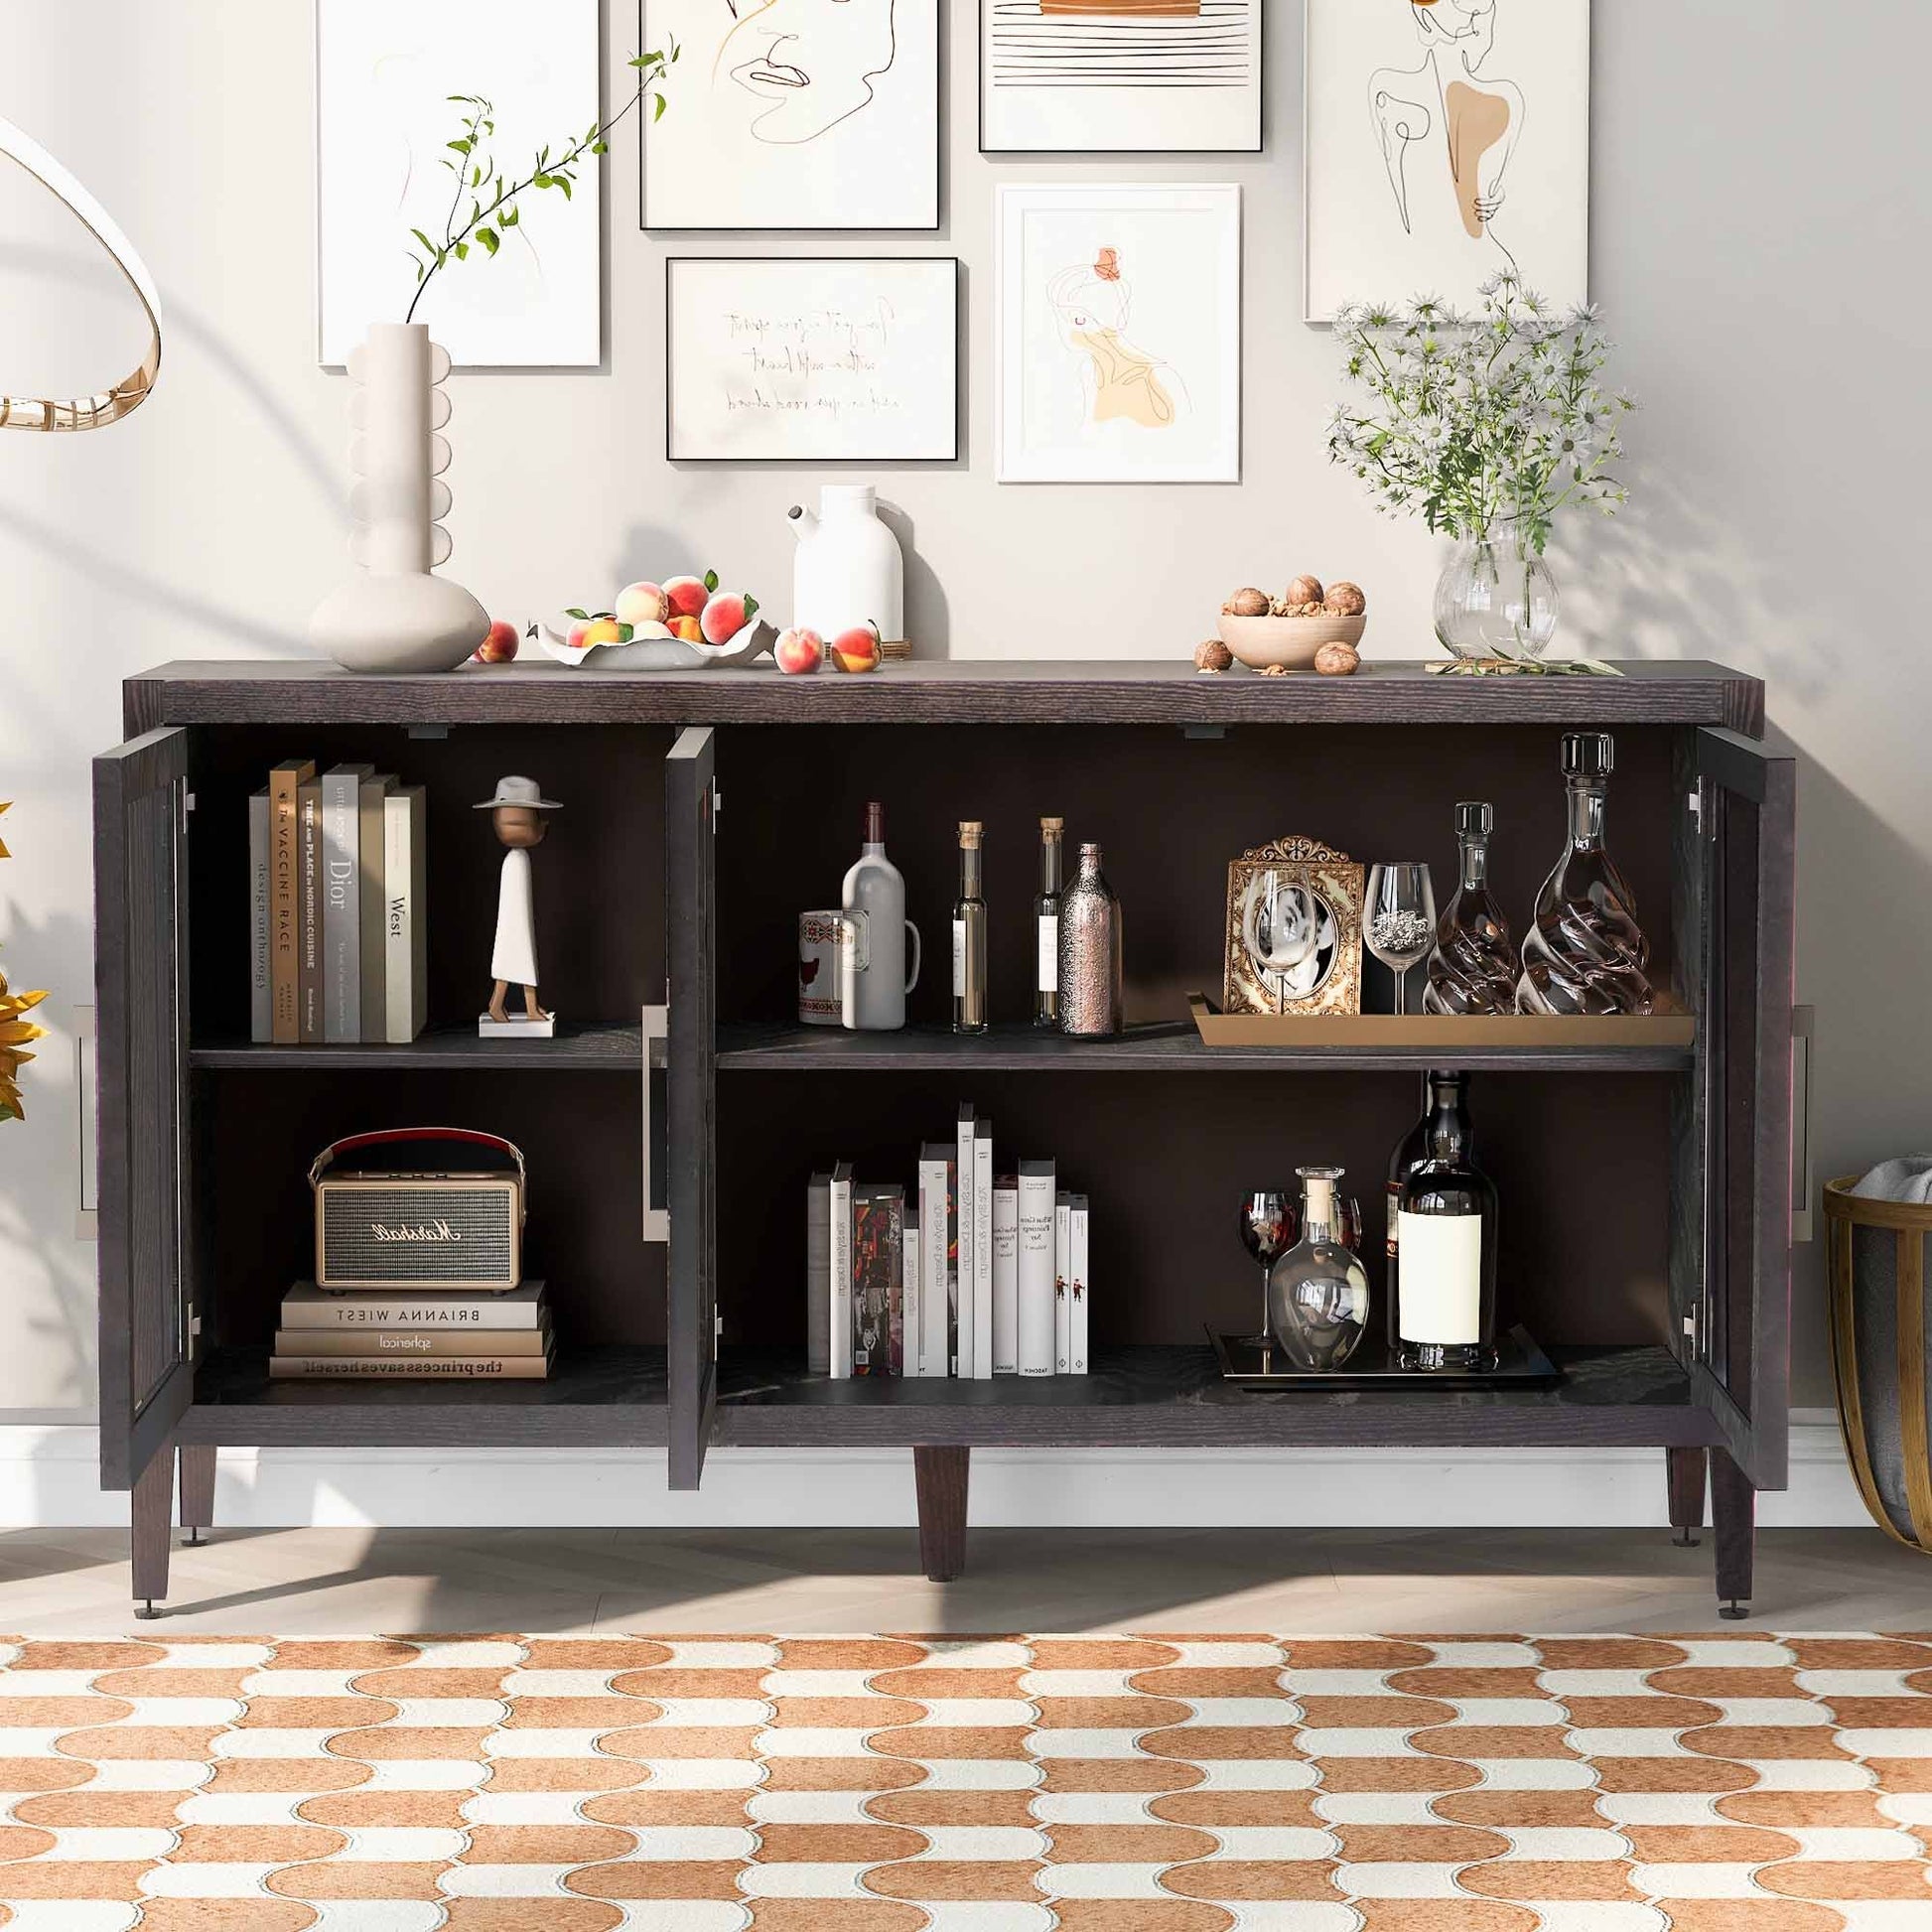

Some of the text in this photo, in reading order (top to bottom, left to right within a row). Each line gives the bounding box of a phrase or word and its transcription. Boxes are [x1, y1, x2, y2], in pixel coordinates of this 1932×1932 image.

[306, 799, 315, 826] TIME
[278, 830, 289, 899] VACCINE
[306, 844, 315, 877] PLACE
[330, 860, 352, 909] Dior
[306, 887, 315, 926] NORDIC
[390, 897, 406, 936] West
[279, 909, 290, 952] RACE
[306, 927, 315, 969] CUISINE
